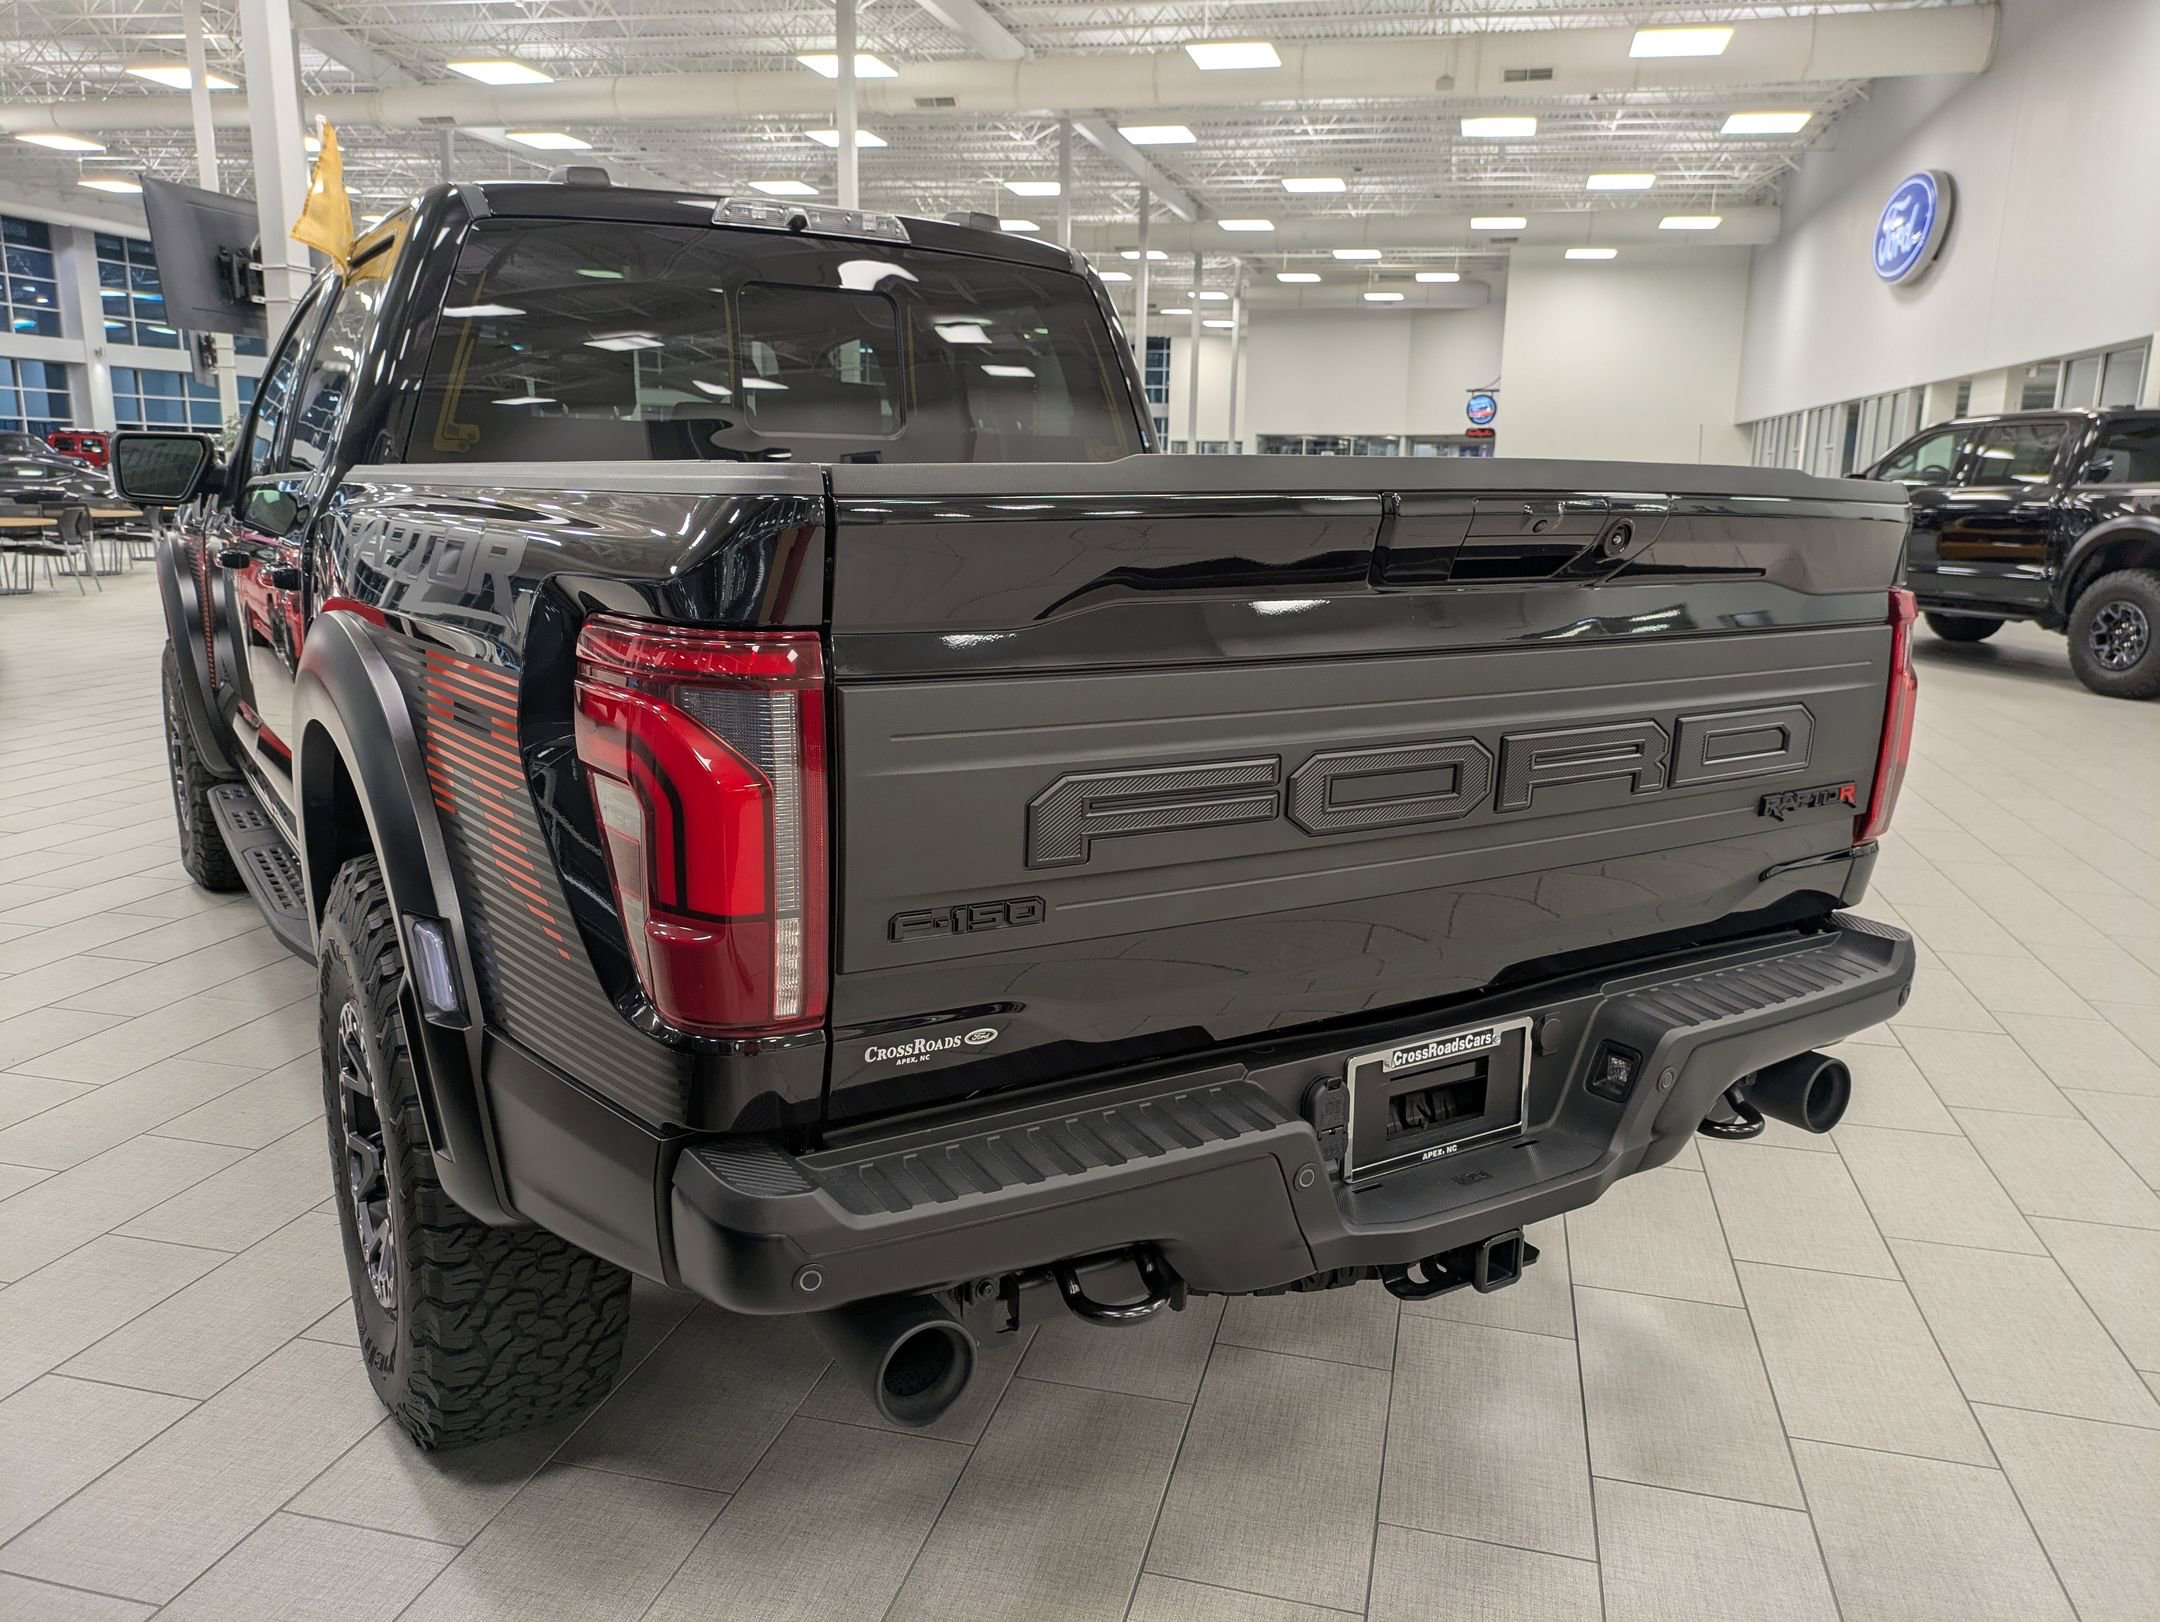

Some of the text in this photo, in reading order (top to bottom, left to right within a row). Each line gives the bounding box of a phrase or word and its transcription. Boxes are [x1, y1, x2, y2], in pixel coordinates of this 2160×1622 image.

[1878, 194, 1921, 267] Ford
[341, 512, 529, 638] RAPTOR
[1024, 704, 1816, 870] FORD
[1759, 781, 1857, 821] RAPTOR
[888, 896, 1046, 943] F-150
[895, 1053, 931, 1066] APEX, NC
[1393, 1033, 1492, 1067] CrossRoadsCars
[1446, 1144, 1458, 1154] NC
